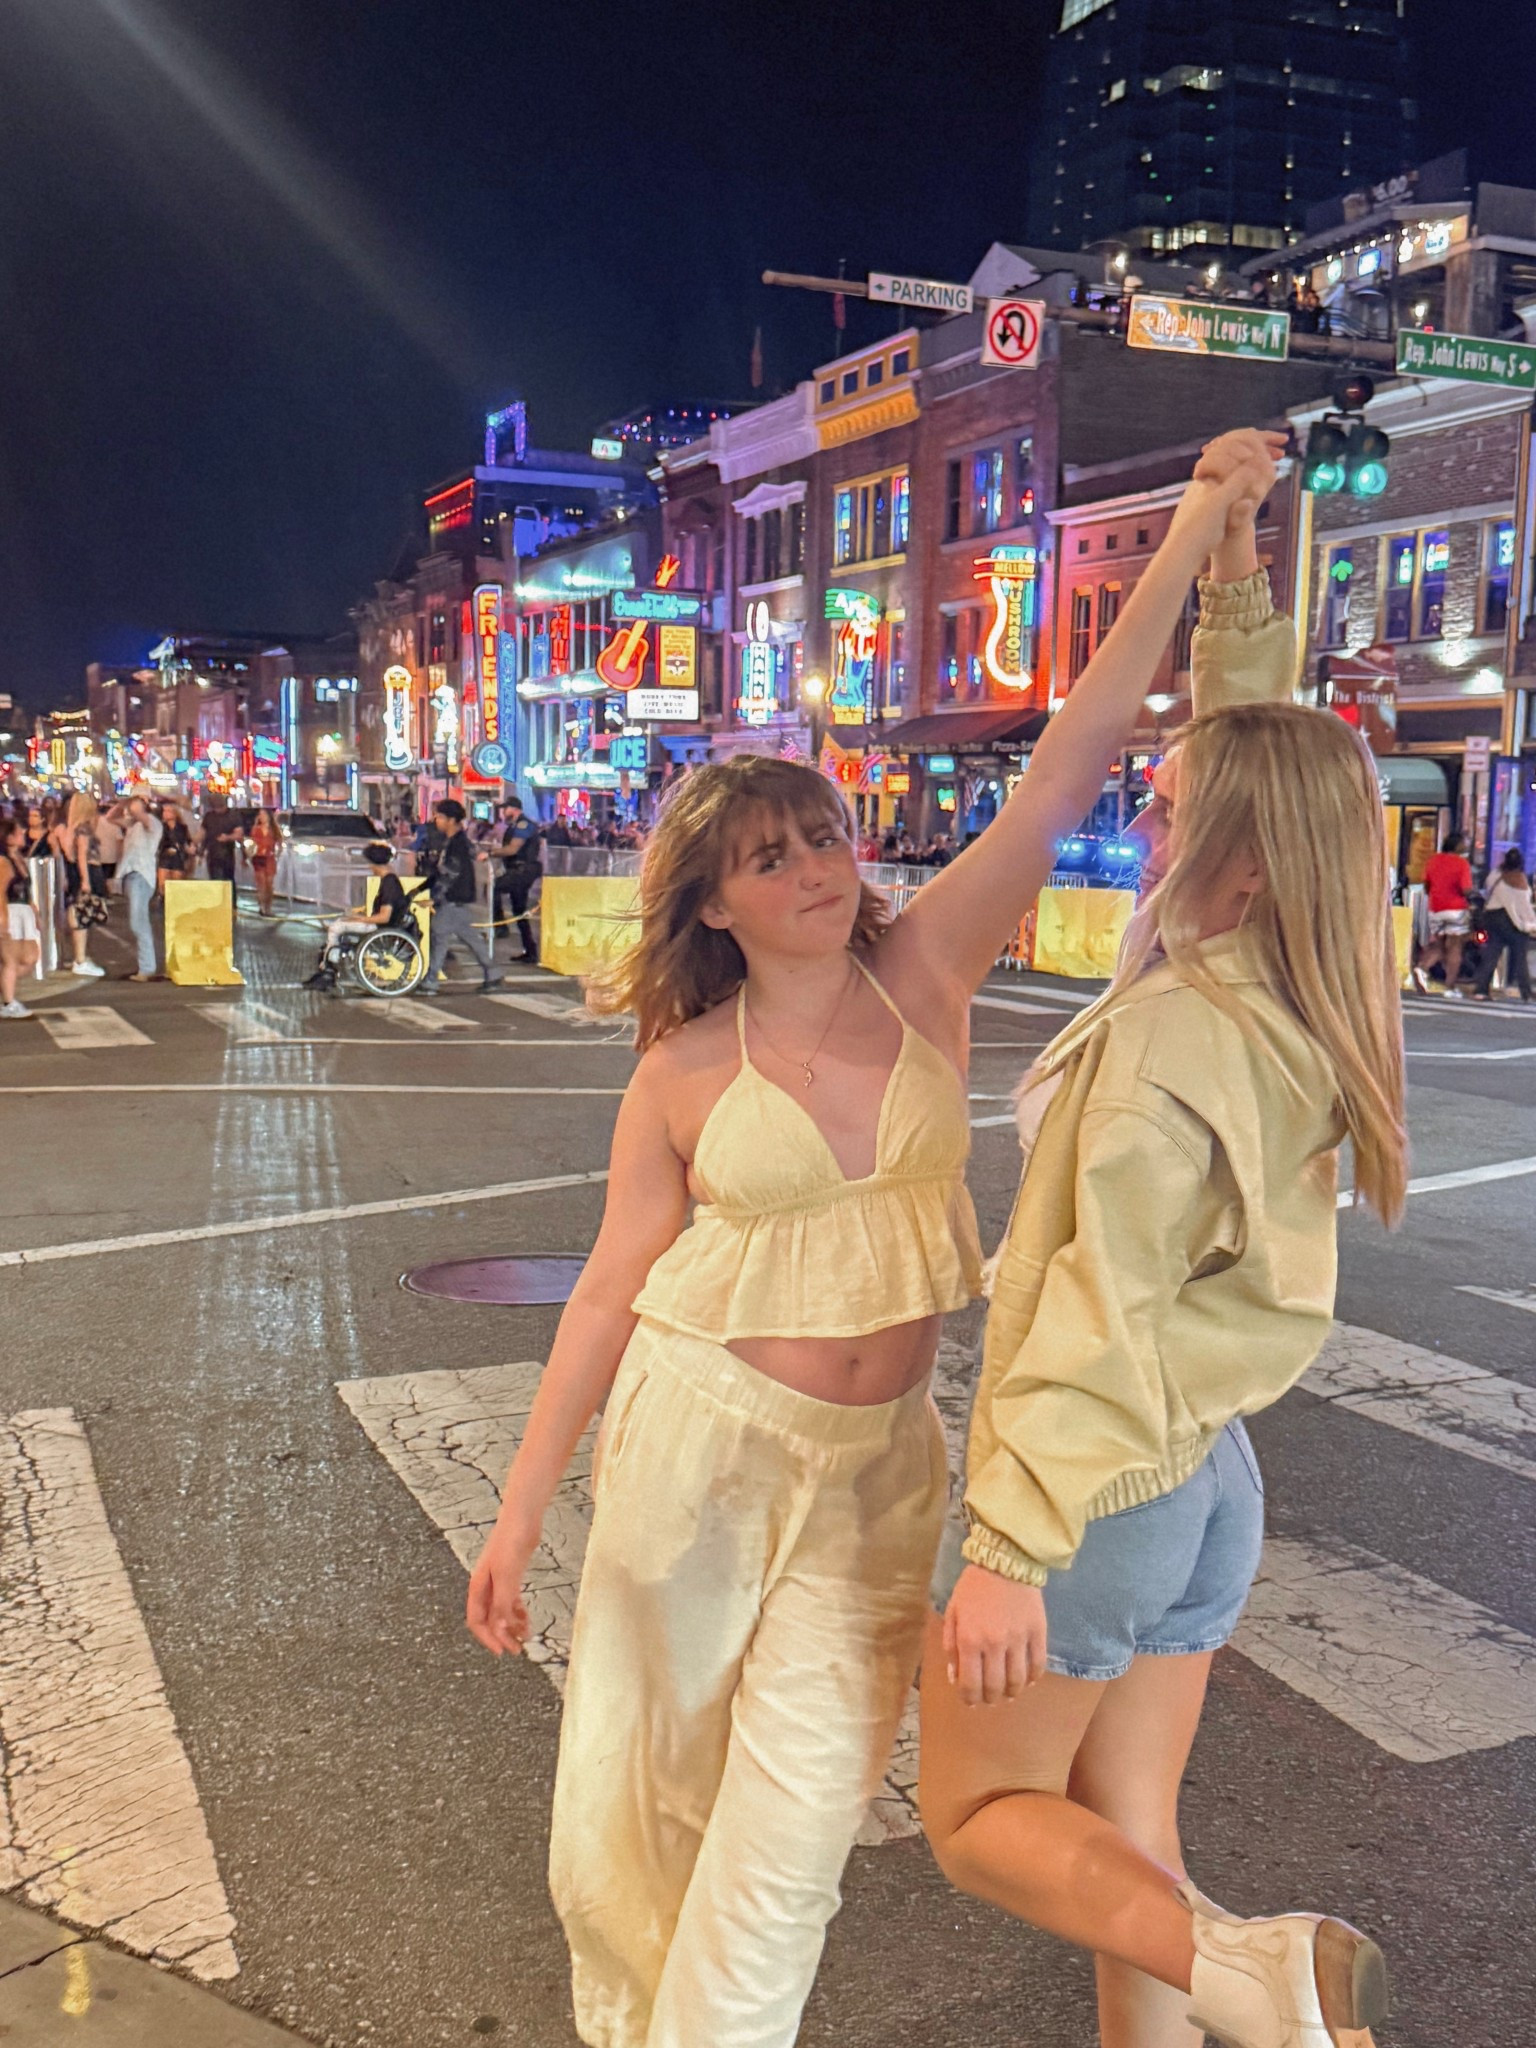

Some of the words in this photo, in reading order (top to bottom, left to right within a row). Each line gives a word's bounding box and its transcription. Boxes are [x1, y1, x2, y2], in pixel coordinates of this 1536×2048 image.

[890, 280, 967, 309] PARKING
[1156, 306, 1182, 341] Rep.
[1183, 310, 1211, 339] John
[1214, 314, 1248, 343] Lewis
[1271, 324, 1280, 348] N
[1405, 337, 1426, 368] Rep.
[1429, 340, 1455, 367] John
[1457, 343, 1488, 371] Lewis
[1508, 353, 1517, 378] S
[1005, 579, 1023, 673] MUSHROOM
[478, 592, 499, 743] FRIENDS
